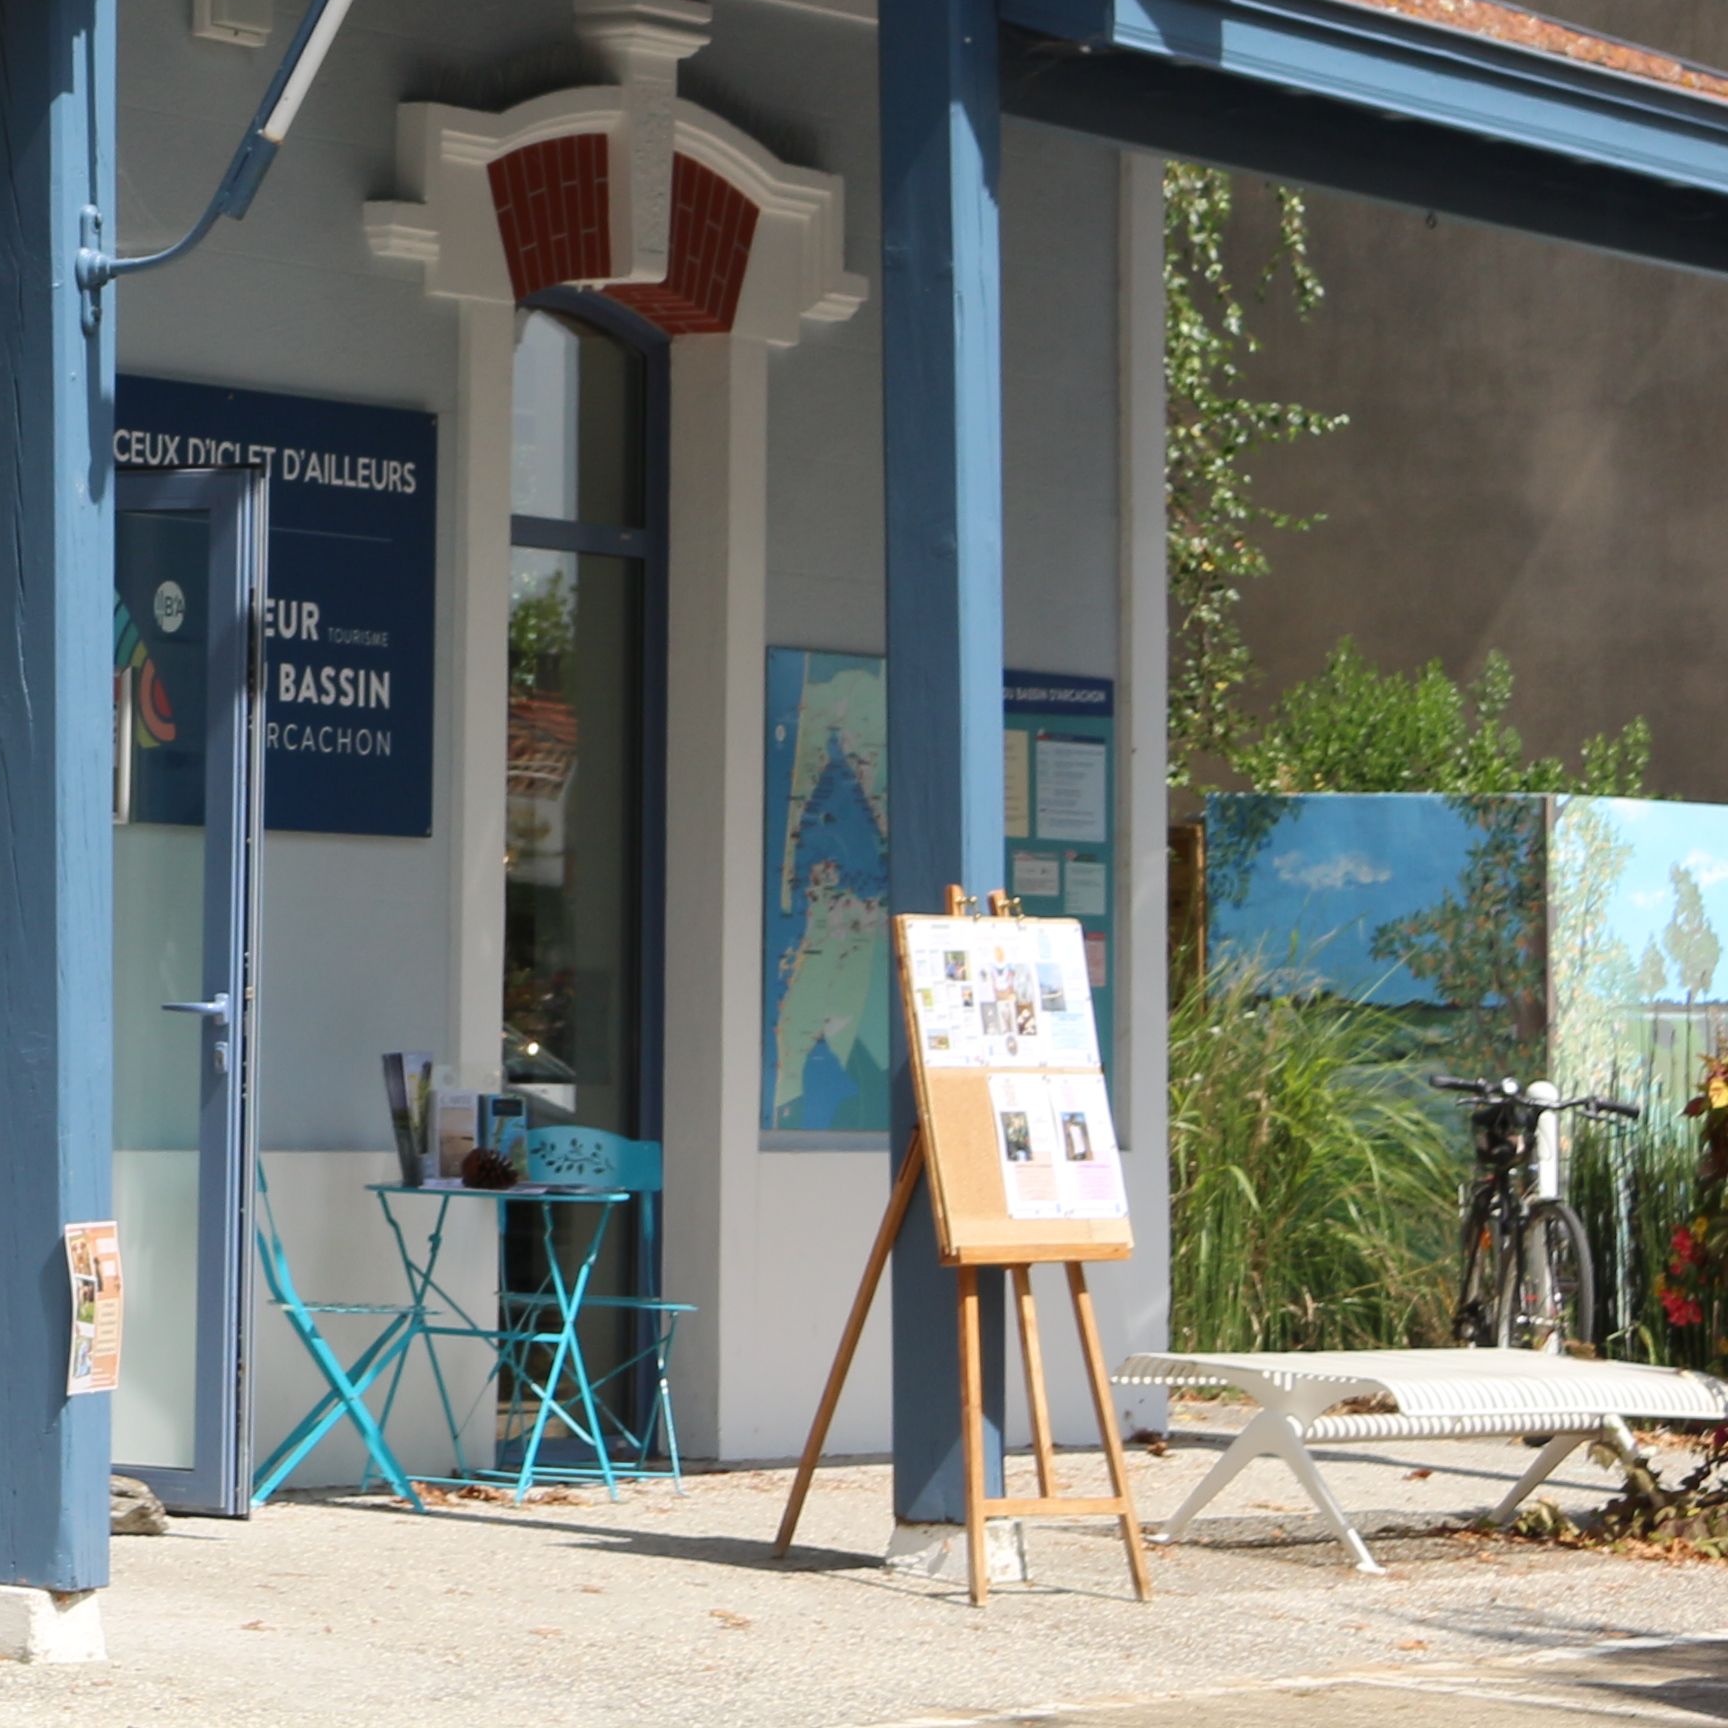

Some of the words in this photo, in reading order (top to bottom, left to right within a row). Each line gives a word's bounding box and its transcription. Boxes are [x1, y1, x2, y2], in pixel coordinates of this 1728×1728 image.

[113, 429, 181, 465] CEUX
[282, 449, 417, 494] D'AILLEURS
[328, 627, 389, 647] TOURISME
[279, 662, 391, 710] BASSIN
